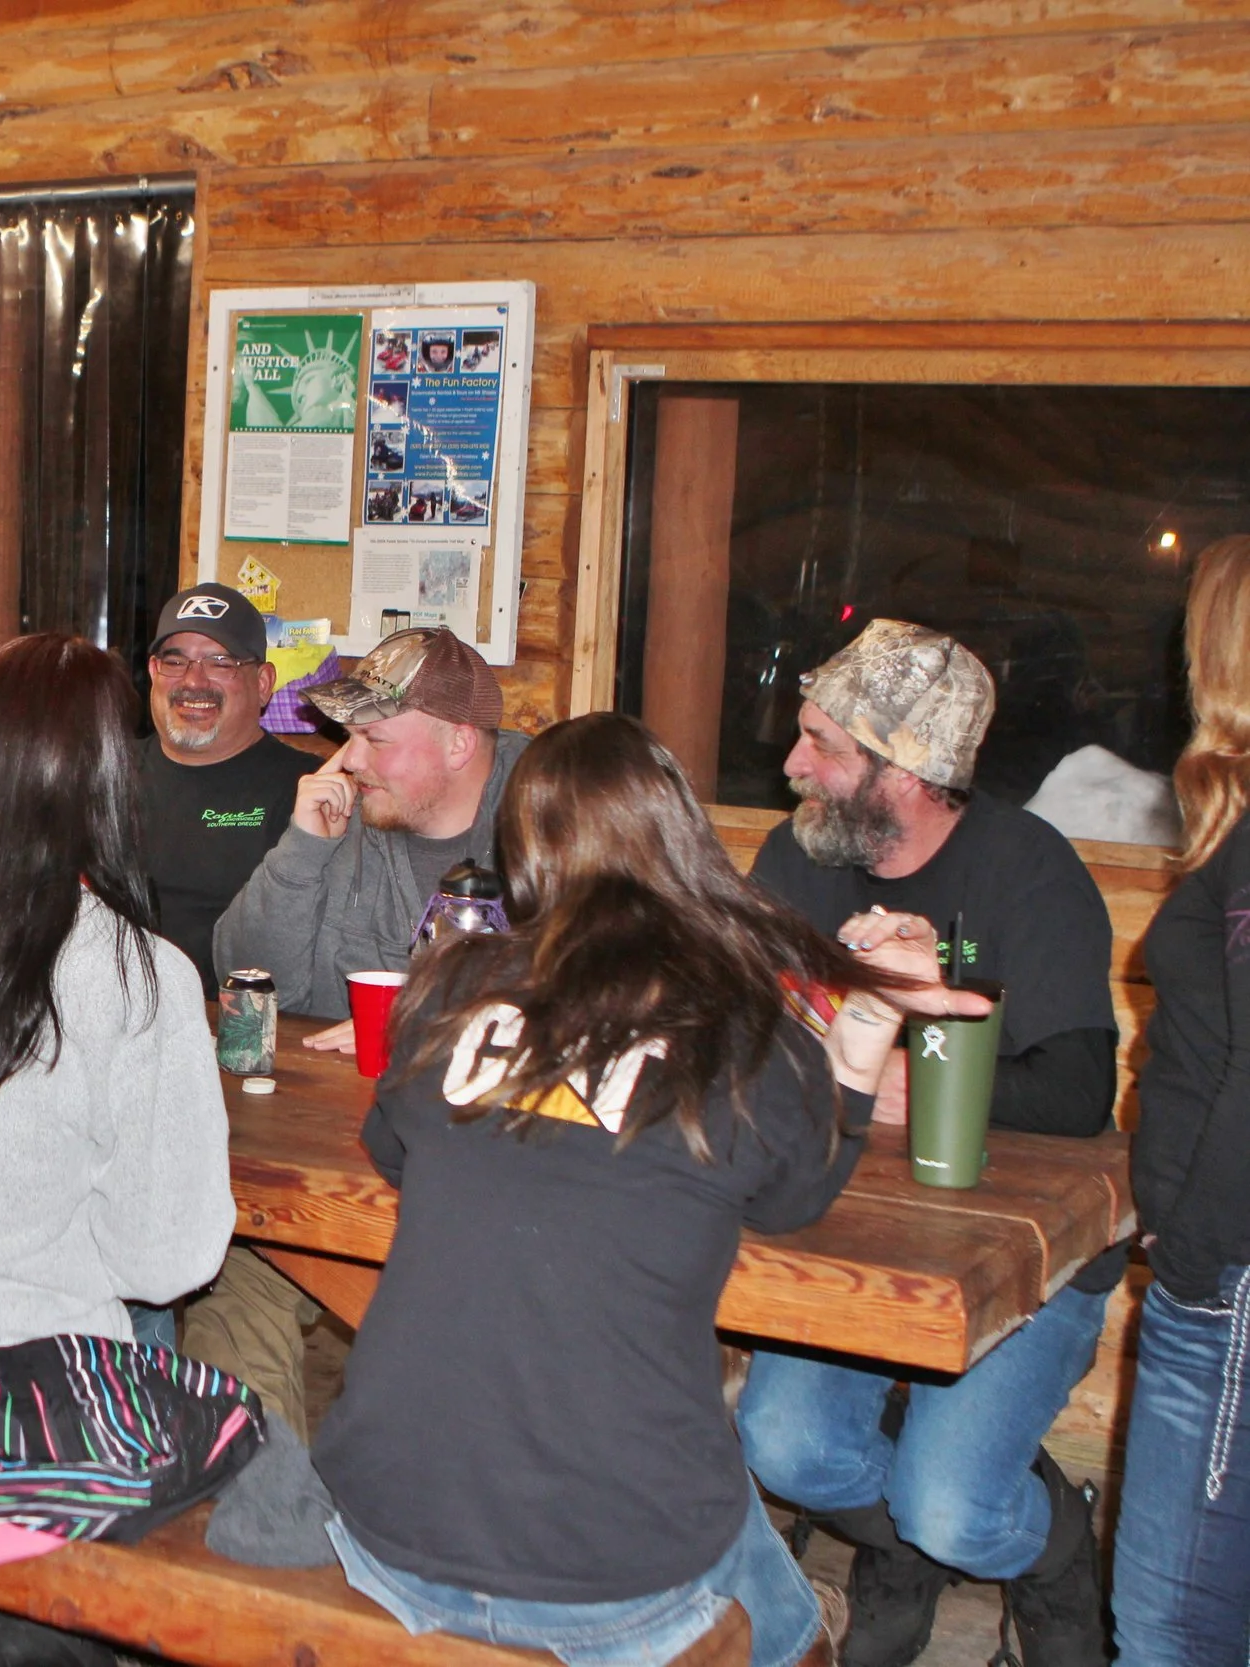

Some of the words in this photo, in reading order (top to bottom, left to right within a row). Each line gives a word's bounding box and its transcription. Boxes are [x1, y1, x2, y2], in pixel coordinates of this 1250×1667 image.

[241, 343, 271, 355] AND
[242, 355, 300, 368] JUSTICE
[254, 369, 281, 380] ALL
[425, 378, 440, 387] The
[443, 378, 460, 387] Fun
[462, 377, 497, 389] Factory
[201, 809, 245, 823] Rogue
